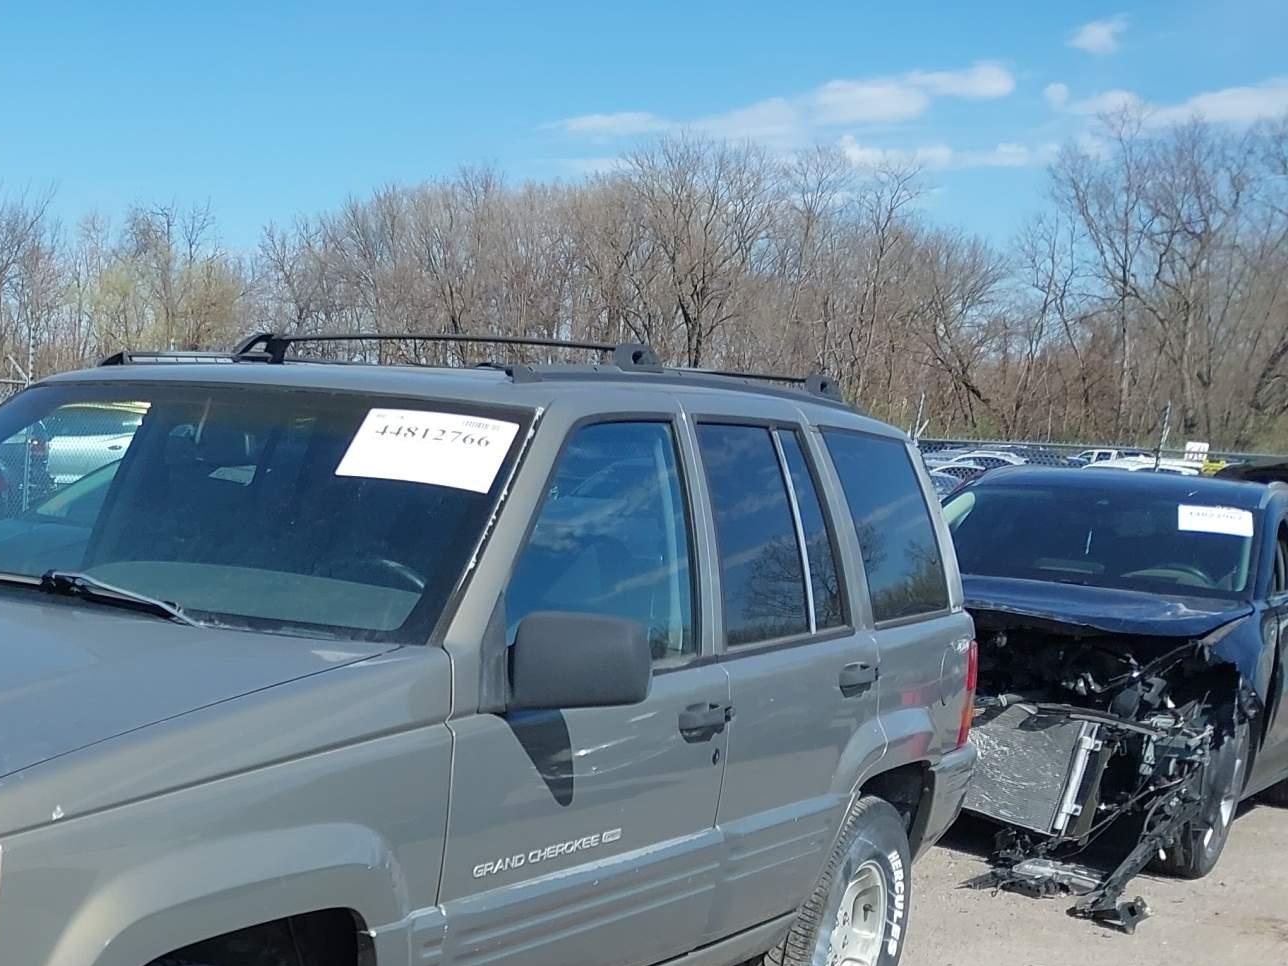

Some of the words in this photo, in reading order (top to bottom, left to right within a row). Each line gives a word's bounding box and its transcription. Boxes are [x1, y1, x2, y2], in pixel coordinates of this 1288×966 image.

[375, 424, 491, 448] 44812766
[472, 853, 526, 878] GRAND
[527, 833, 601, 864] CHEROKEE
[887, 849, 905, 957] HERCULES
